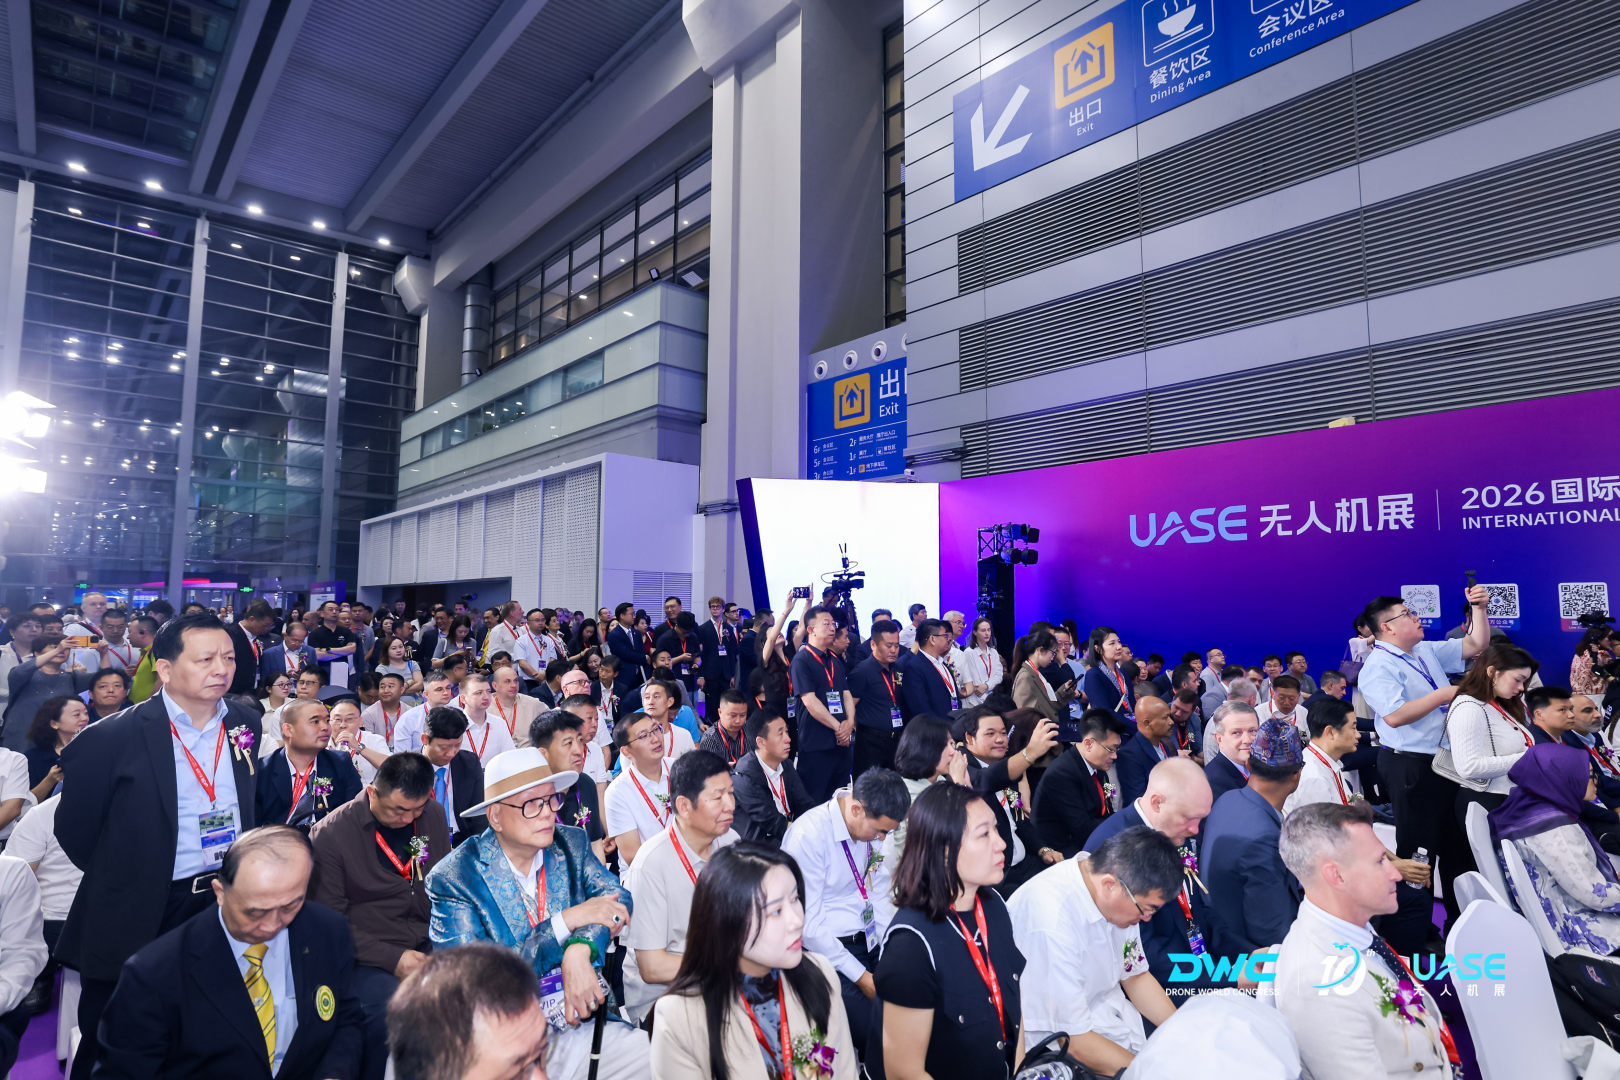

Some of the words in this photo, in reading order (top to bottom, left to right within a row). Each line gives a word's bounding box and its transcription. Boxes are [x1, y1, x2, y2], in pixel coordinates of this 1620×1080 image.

[1249, 22, 1315, 58] Conference
[1316, 9, 1345, 28] Area
[1149, 45, 1211, 89] 餐饮区
[1150, 82, 1185, 104] Dining
[1186, 70, 1211, 88] Area
[1069, 98, 1101, 127] 出口
[1076, 122, 1094, 137] Exit
[879, 367, 907, 399] 出
[879, 402, 899, 418] Exit
[1129, 504, 1248, 548] UASE
[1259, 493, 1415, 538] 无人机展
[1462, 507, 1620, 530] INTERNATIONAL
